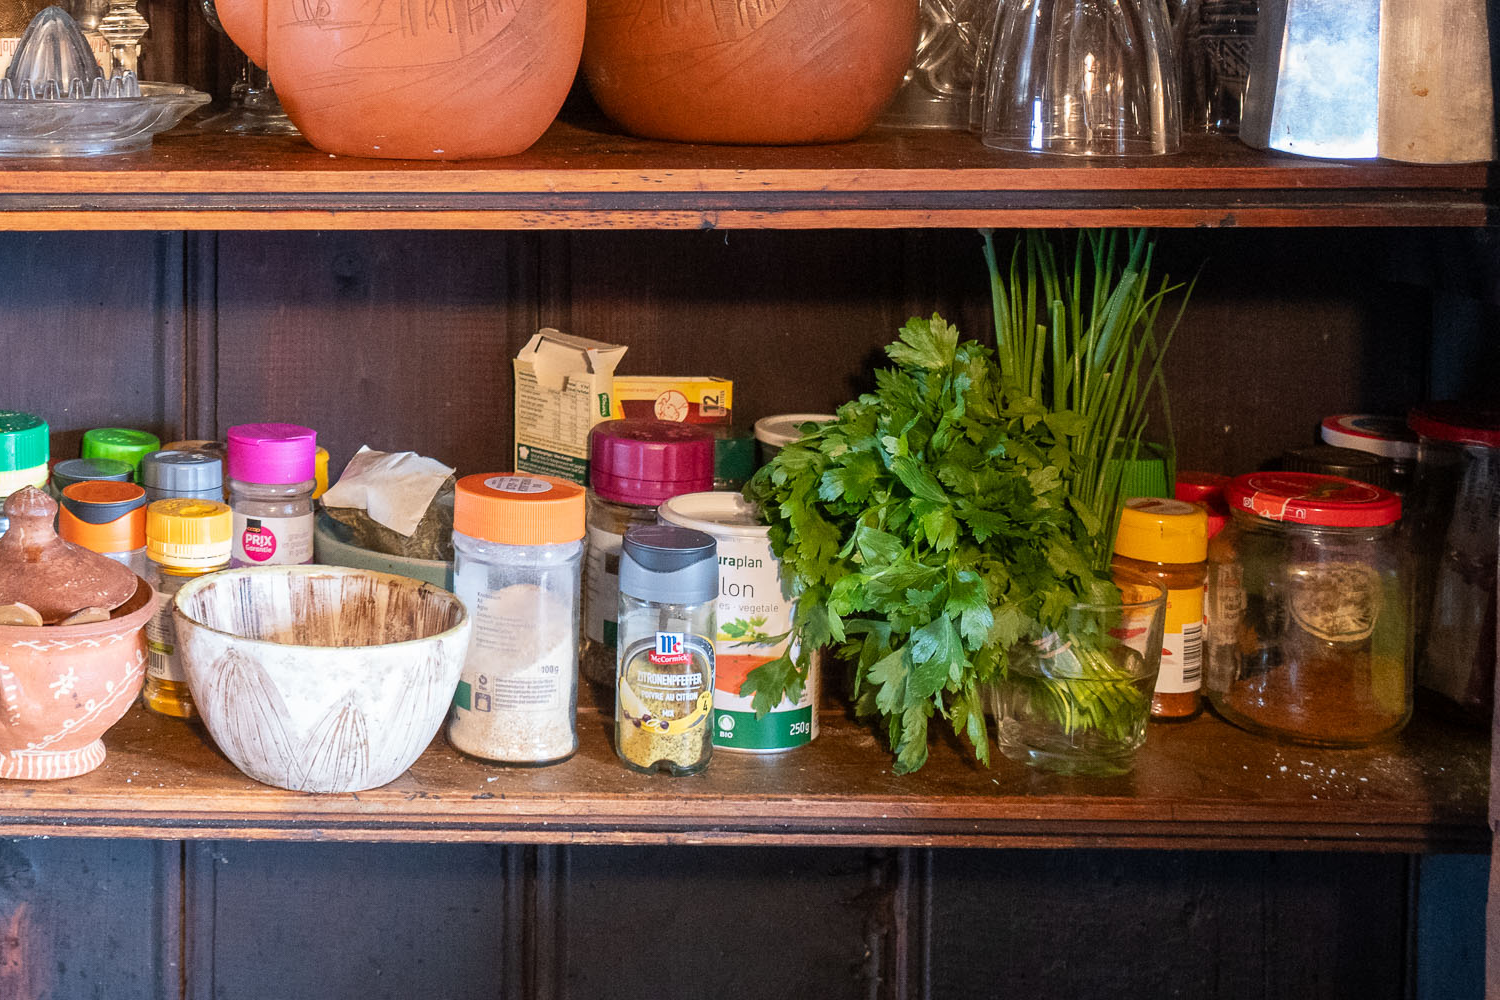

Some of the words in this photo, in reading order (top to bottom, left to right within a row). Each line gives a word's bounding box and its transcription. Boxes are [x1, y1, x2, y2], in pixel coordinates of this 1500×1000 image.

[702, 395, 719, 413] 12
[722, 577, 754, 598] lon
[740, 603, 779, 614] vegetale
[650, 653, 689, 663] McCormick
[637, 671, 702, 686] ZITRONENPFEFFER
[641, 689, 664, 701] POIVRE
[665, 692, 675, 702] AU
[675, 690, 699, 702] CITRON
[719, 731, 734, 739] BIO
[789, 721, 810, 736] 250g
